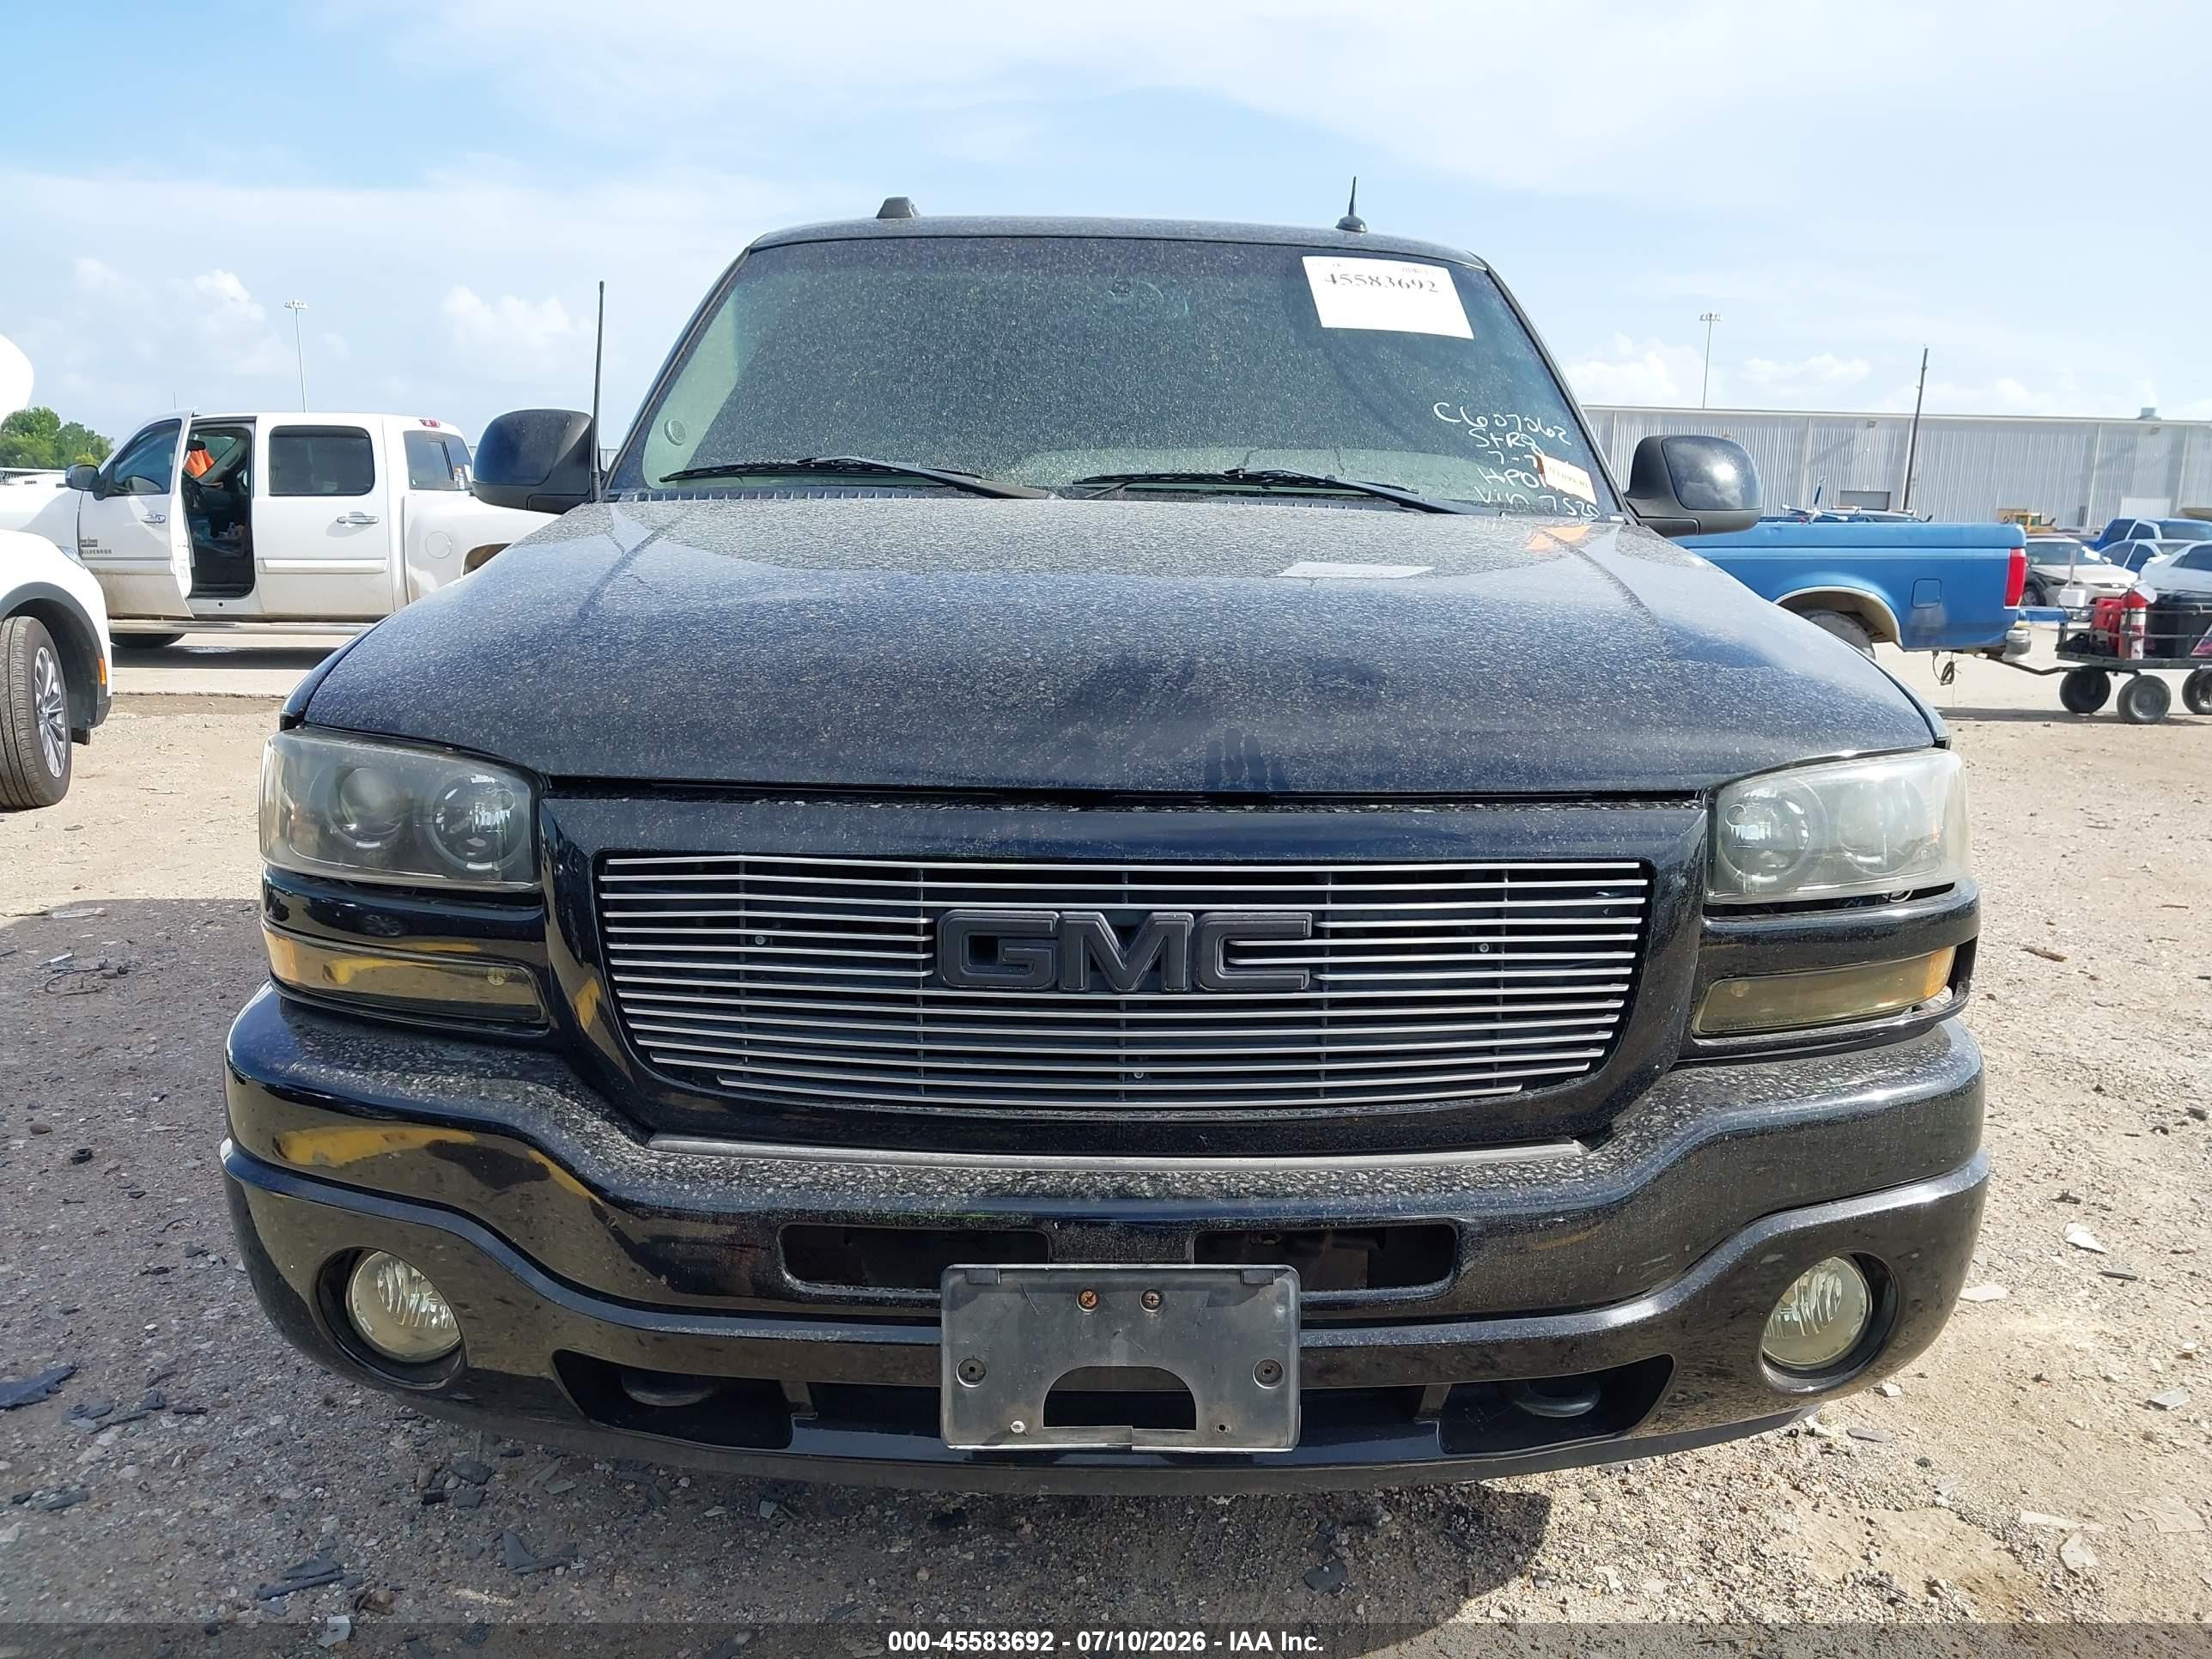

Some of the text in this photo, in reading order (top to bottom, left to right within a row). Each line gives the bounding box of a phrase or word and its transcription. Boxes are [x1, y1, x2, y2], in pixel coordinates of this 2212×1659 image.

[1325, 273, 1439, 293] 45583692
[1433, 402, 1571, 446] C607062
[937, 909, 1312, 993] GMC
